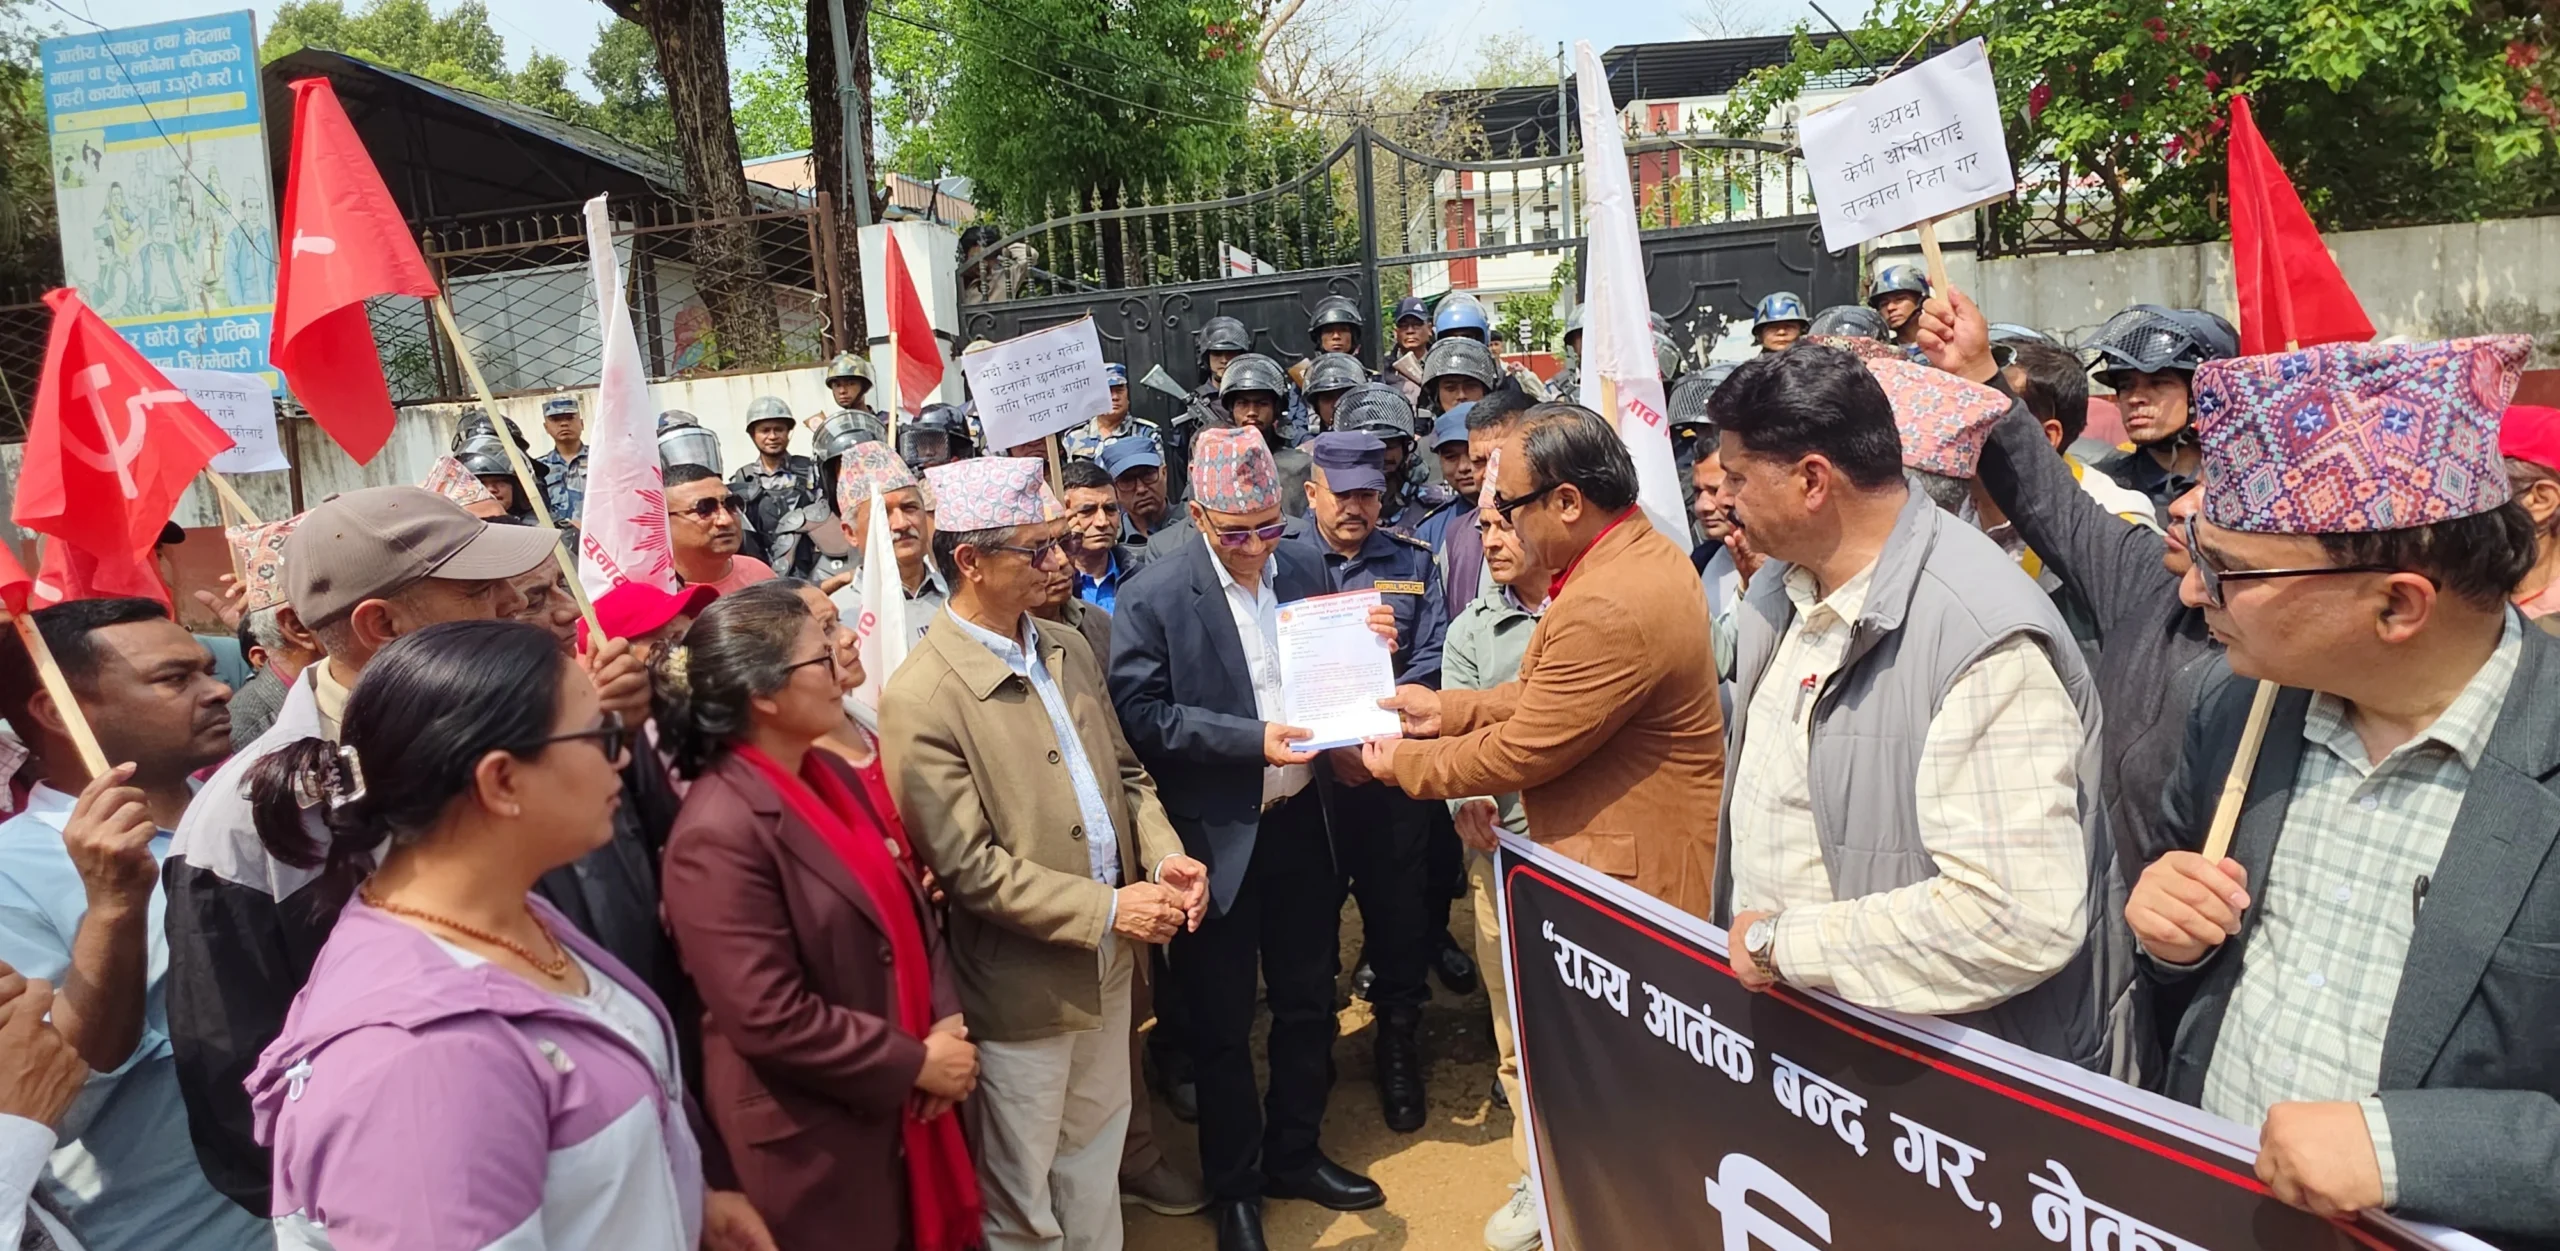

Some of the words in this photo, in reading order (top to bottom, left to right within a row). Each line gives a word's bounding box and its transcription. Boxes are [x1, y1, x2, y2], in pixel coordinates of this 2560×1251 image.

[154, 34, 180, 50] तथा
[88, 67, 102, 81] वा
[180, 44, 241, 69] नजिकको
[52, 87, 84, 108] प्रहरी
[1868, 99, 1921, 134] अध्यक्ष
[1841, 154, 1875, 183] केपी
[1884, 114, 1965, 164] ओलीलाई
[1841, 182, 1900, 219] तत्काल
[1906, 165, 1945, 193] रिहा
[1955, 152, 1980, 174] गर
[144, 325, 180, 347] छोरी
[212, 317, 260, 344] प्रतिको
[1007, 360, 1020, 373] २३
[1025, 358, 1032, 367] र
[1036, 352, 1051, 364] २४
[1057, 339, 1085, 357] गतेको
[195, 389, 247, 401] अराजकता
[990, 375, 1032, 397] घटनाको
[995, 398, 1020, 415] लागि
[1024, 388, 1056, 405] निष्पक्ष
[1061, 377, 1090, 394] आयोग
[1028, 408, 1051, 422] गठन
[1056, 402, 1069, 414] गर
[1376, 582, 1397, 590] NEPAL
[1398, 583, 1422, 592] POLICE
[1642, 981, 1755, 1084] आतंक
[1771, 1052, 1868, 1157] बन्द
[1890, 1112, 2002, 1229] गर,
